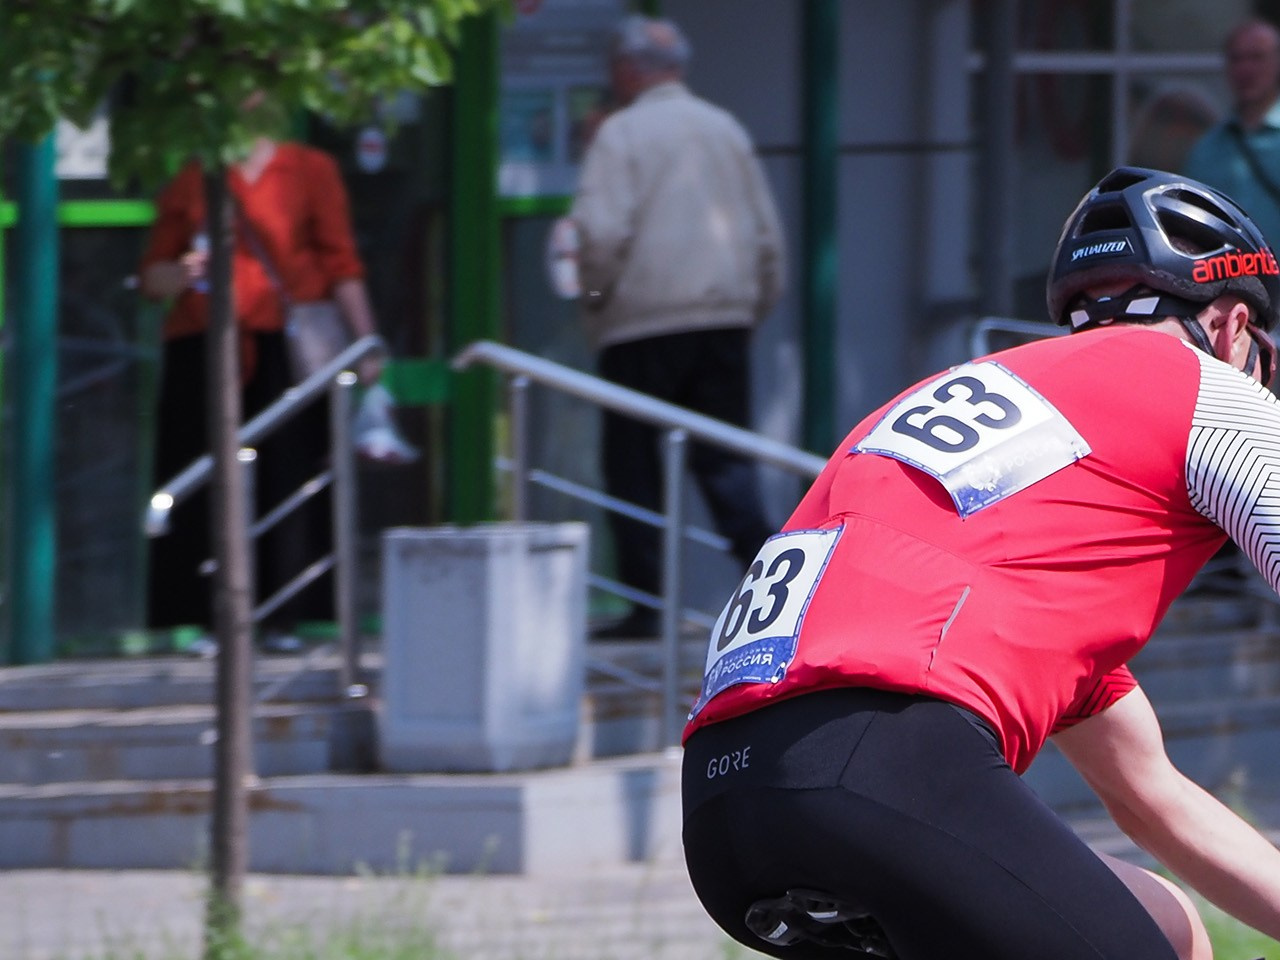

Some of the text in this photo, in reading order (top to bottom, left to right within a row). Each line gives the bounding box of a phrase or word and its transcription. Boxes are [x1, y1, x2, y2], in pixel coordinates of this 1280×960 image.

[891, 375, 1022, 454] 63
[716, 547, 806, 653] 63
[720, 653, 773, 677] РОССИЯ
[706, 745, 753, 780] GORE
